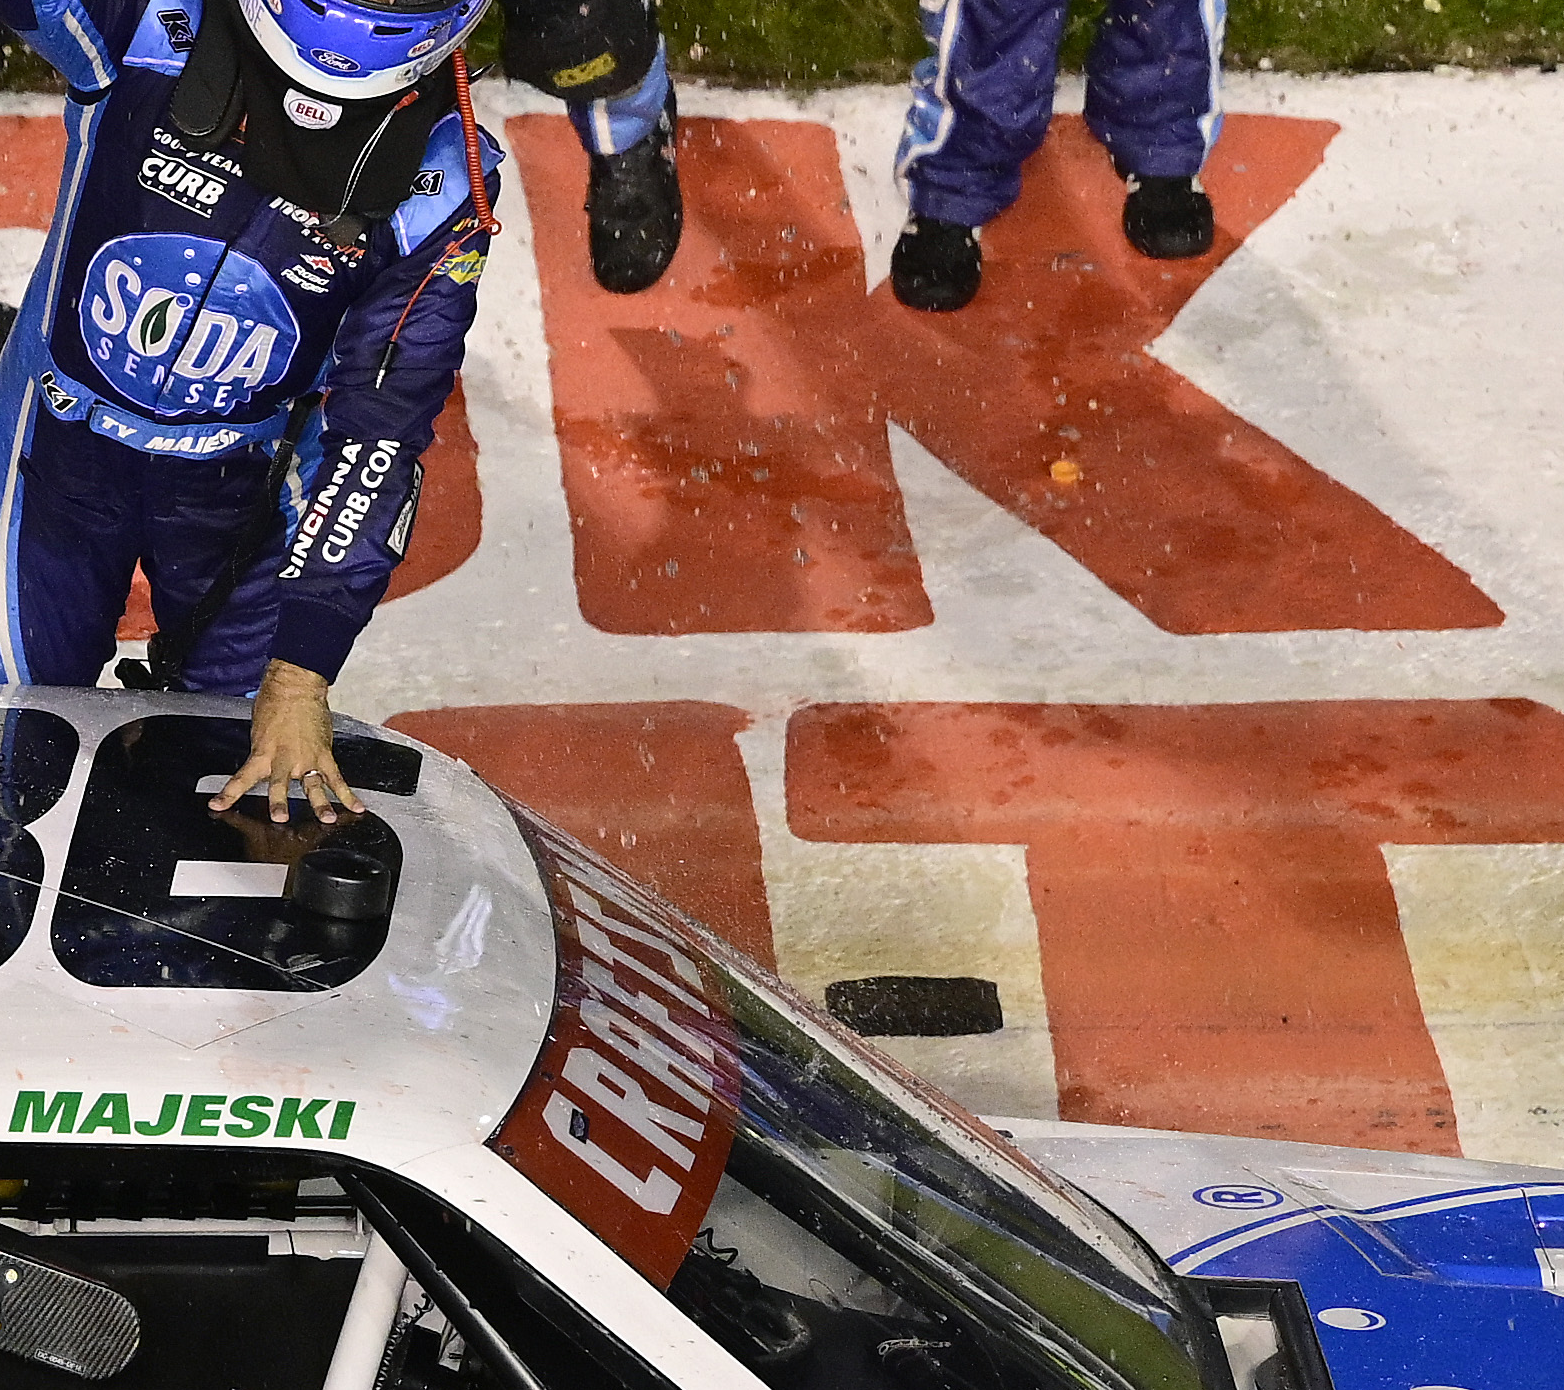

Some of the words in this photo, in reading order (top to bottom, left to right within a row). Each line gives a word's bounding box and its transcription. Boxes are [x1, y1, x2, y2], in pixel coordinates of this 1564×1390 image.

[318, 51, 352, 71] Ford
[295, 102, 327, 122] BELL
[141, 157, 225, 207] CURB
[281, 268, 329, 295] Ranger
[292, 263, 330, 288] Road
[91, 259, 279, 387] SODA
[96, 336, 233, 408] SENSE
[101, 415, 138, 438] TY
[9, 1089, 358, 1141] MAJESKI
